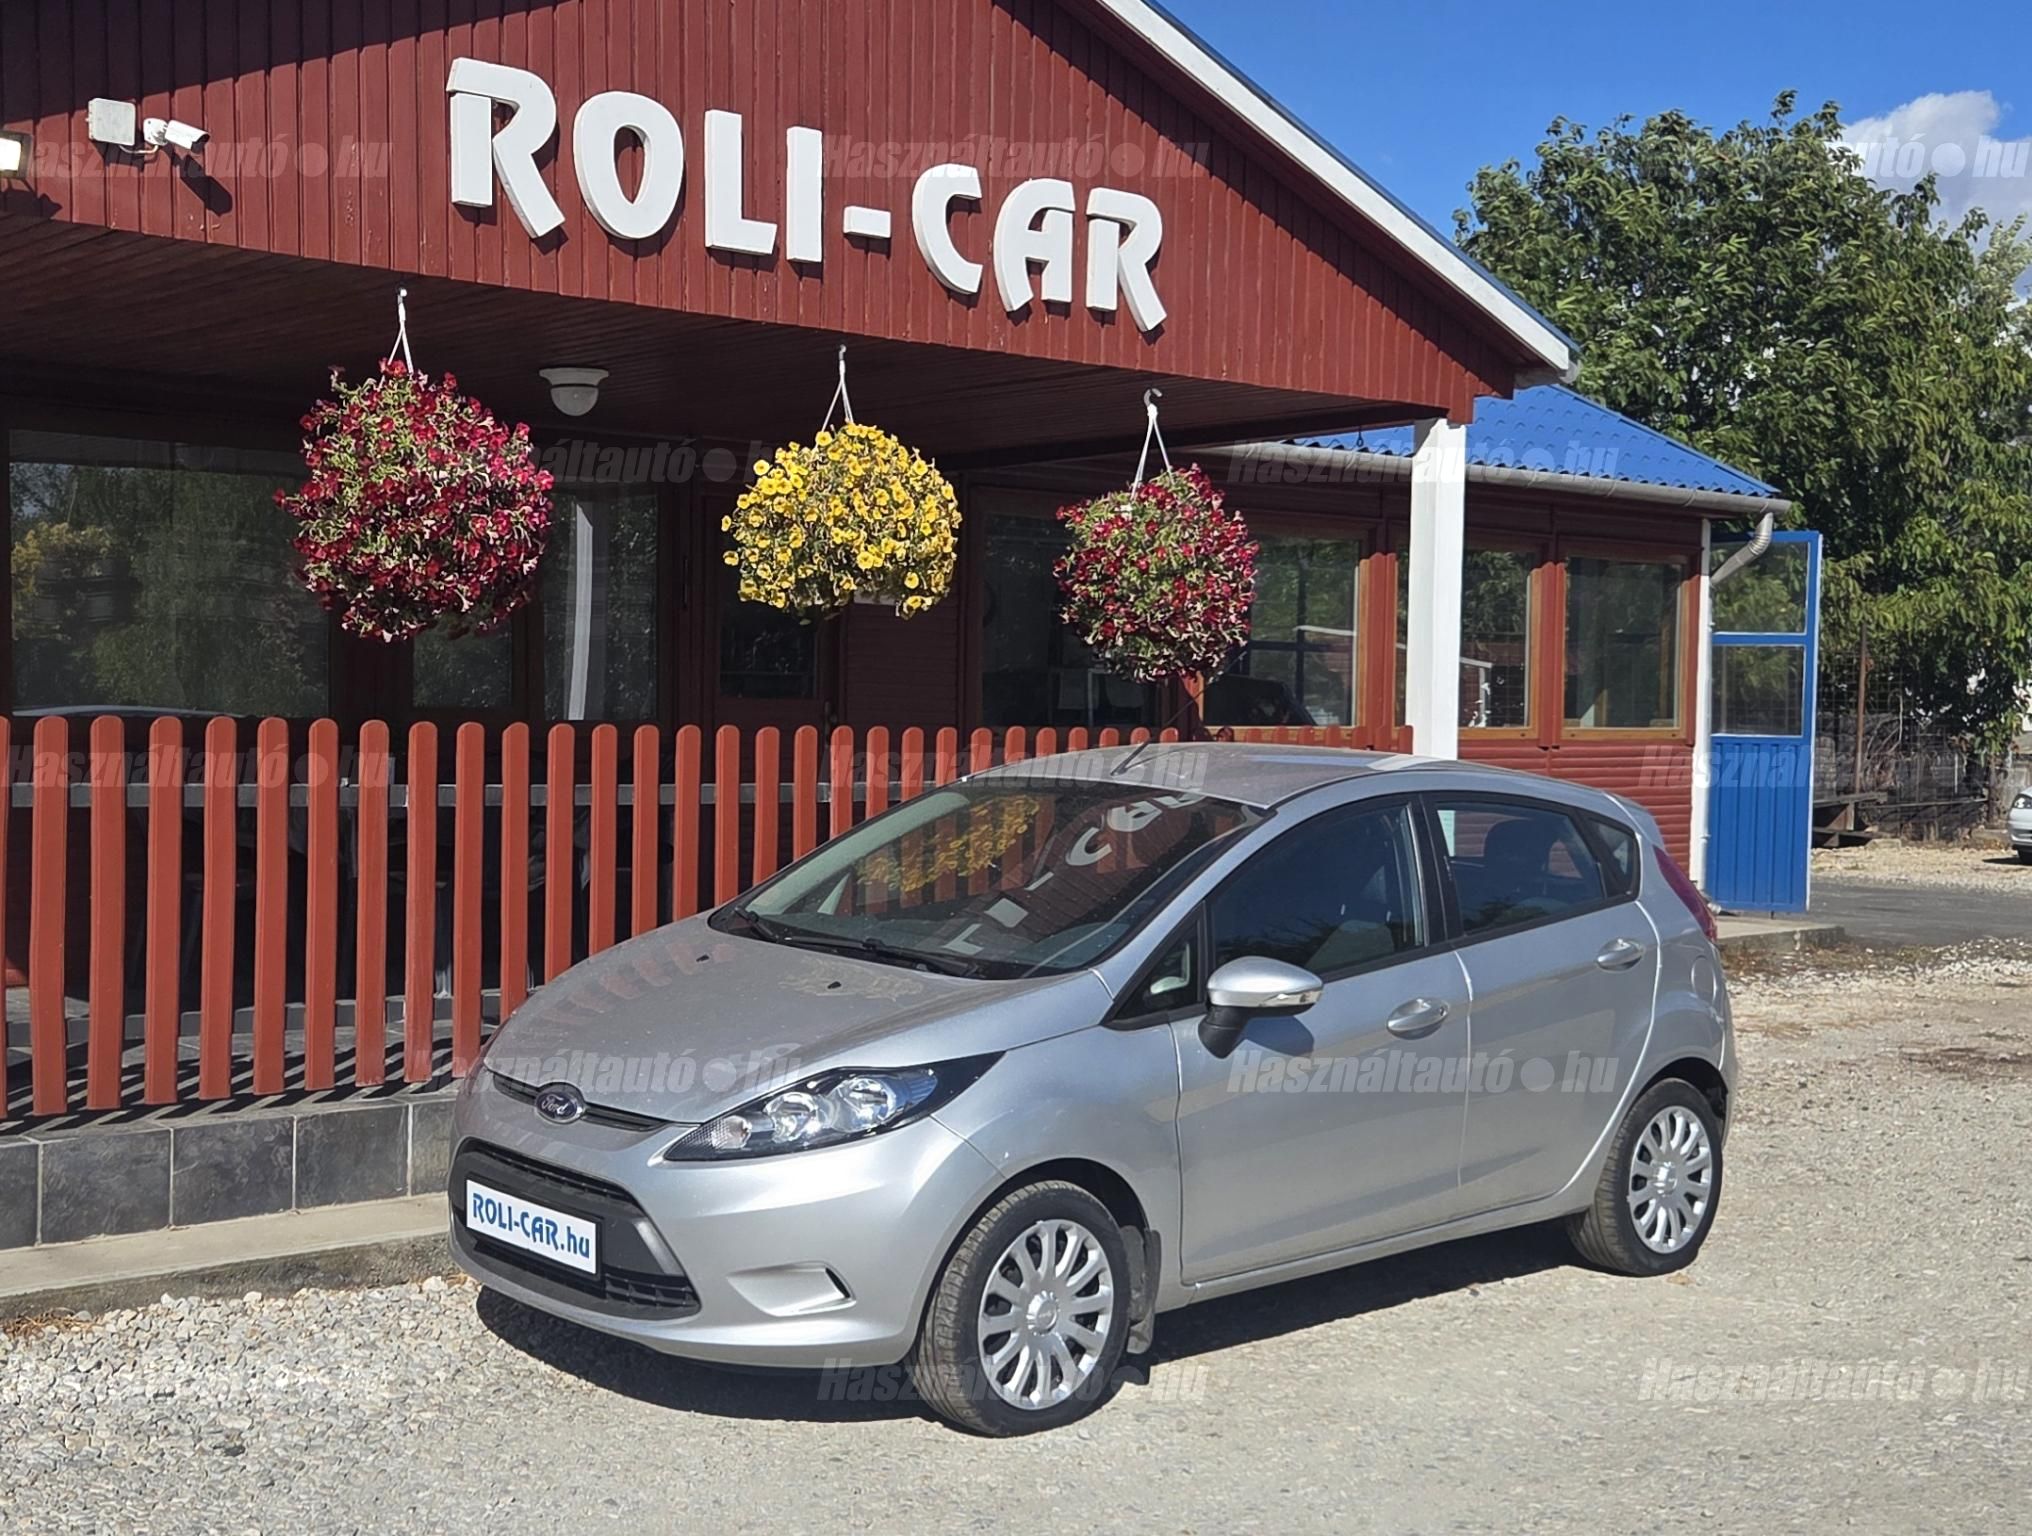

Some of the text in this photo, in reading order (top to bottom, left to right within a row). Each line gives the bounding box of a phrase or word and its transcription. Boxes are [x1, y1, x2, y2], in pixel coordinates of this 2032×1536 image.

[446, 57, 1167, 332] ROLI-CAR
[541, 1093, 569, 1116] Ford
[472, 1192, 590, 1259] ROLI-CAR.hu
